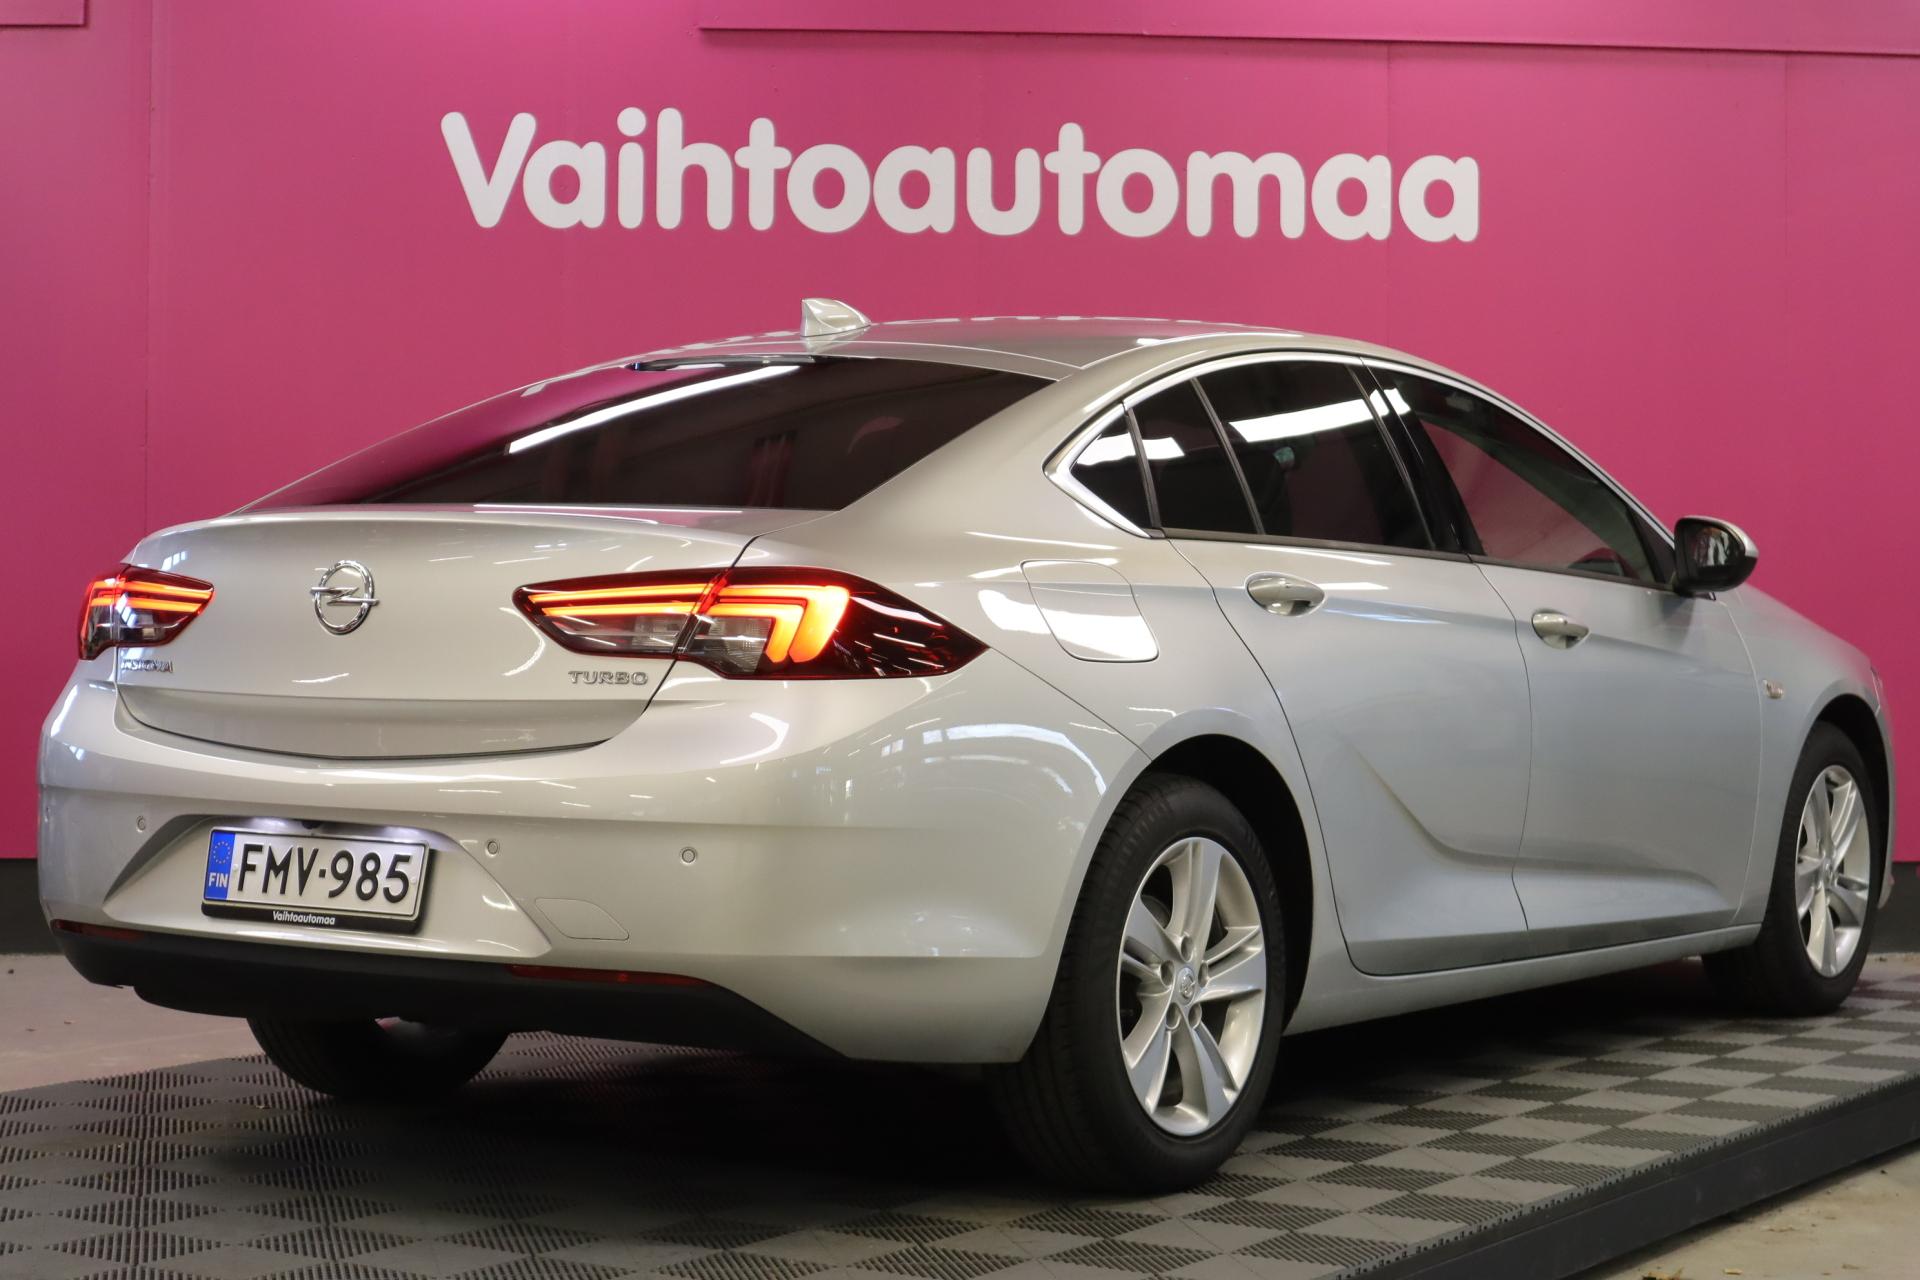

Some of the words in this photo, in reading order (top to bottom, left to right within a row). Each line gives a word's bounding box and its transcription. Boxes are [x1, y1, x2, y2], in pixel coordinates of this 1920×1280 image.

[440, 106, 1481, 243] Vaihtoautomaa
[568, 670, 648, 685] TURBO
[208, 872, 228, 888] FIN
[272, 910, 336, 926] Vaihtoautomaa
